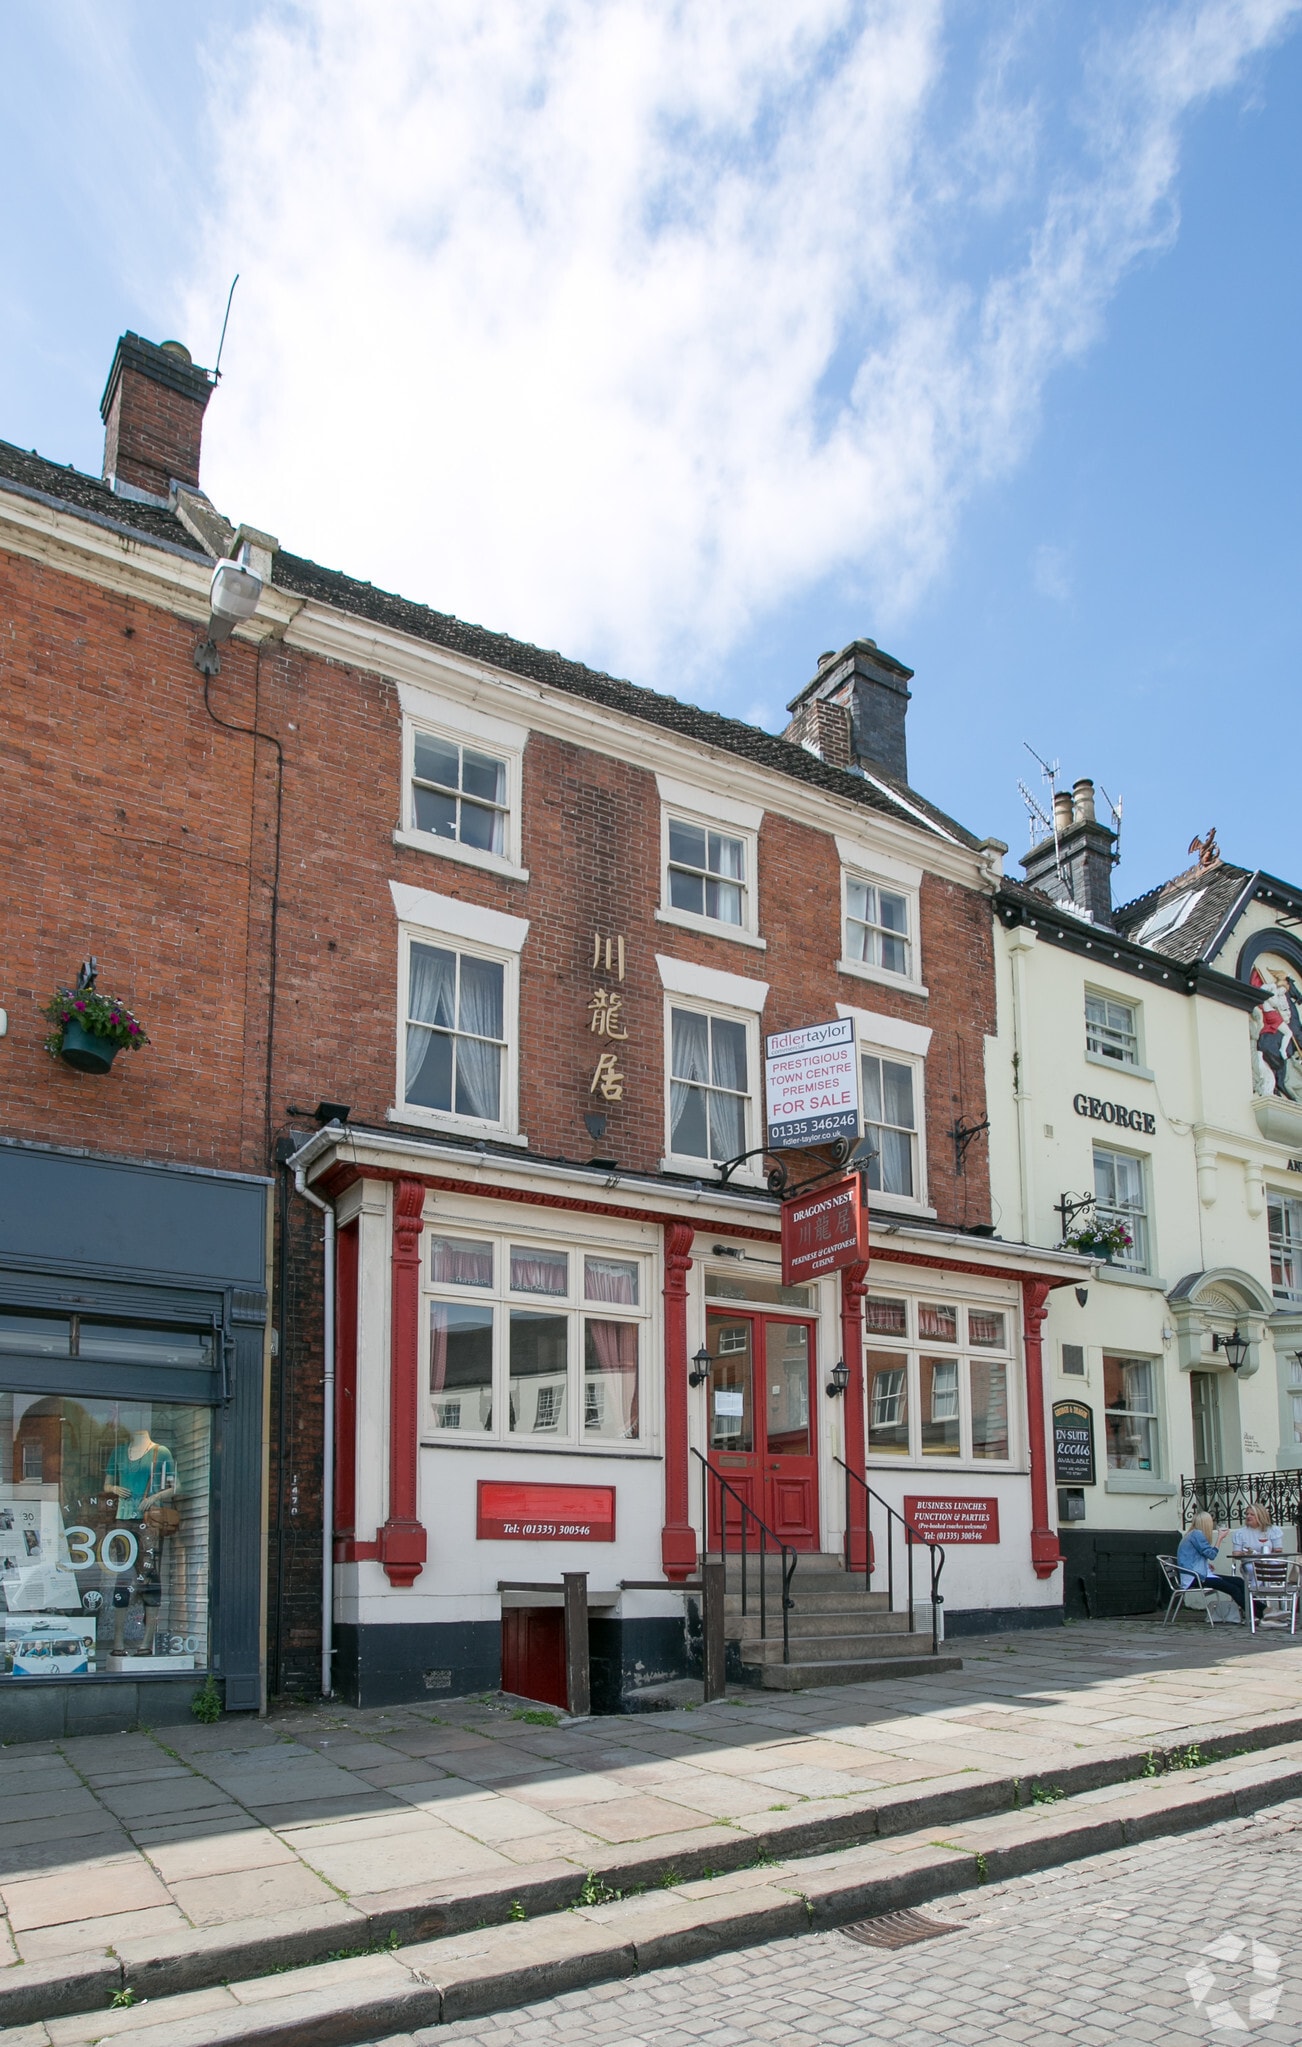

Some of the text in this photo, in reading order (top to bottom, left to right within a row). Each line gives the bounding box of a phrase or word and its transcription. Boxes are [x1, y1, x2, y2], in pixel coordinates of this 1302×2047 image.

[588, 933, 629, 1101] 川龍居
[771, 1025, 847, 1050] fidlertaylor
[772, 1050, 848, 1073] PRESTIGIOUS
[770, 1062, 852, 1086] TOWN CENTRE
[782, 1078, 840, 1096] PREMISES
[773, 1091, 851, 1116] FOR SALE
[1073, 1093, 1156, 1135] GEORGE
[771, 1113, 855, 1138] 01335 346246
[782, 1129, 842, 1146] fidler-taylor.co.uk
[793, 1190, 854, 1223] DRAGON'S NEST
[791, 1250, 818, 1266] PEKINESE
[823, 1238, 857, 1255] CANTONESE
[812, 1256, 835, 1269] CUISINE
[1056, 1442, 1090, 1456] ROOMS
[1057, 1457, 1090, 1465] AVAILABLE
[917, 1501, 987, 1511] BUSINESS LUNCHES
[22, 1512, 35, 1521] 30
[914, 1512, 990, 1522] FUNCTION & PARTIES
[503, 1523, 590, 1536] Tel: (01335) 300546
[924, 1532, 935, 1540] Tel:
[937, 1532, 960, 1541] (01335)
[59, 1525, 139, 1573] 30
[169, 1635, 200, 1655] 30
